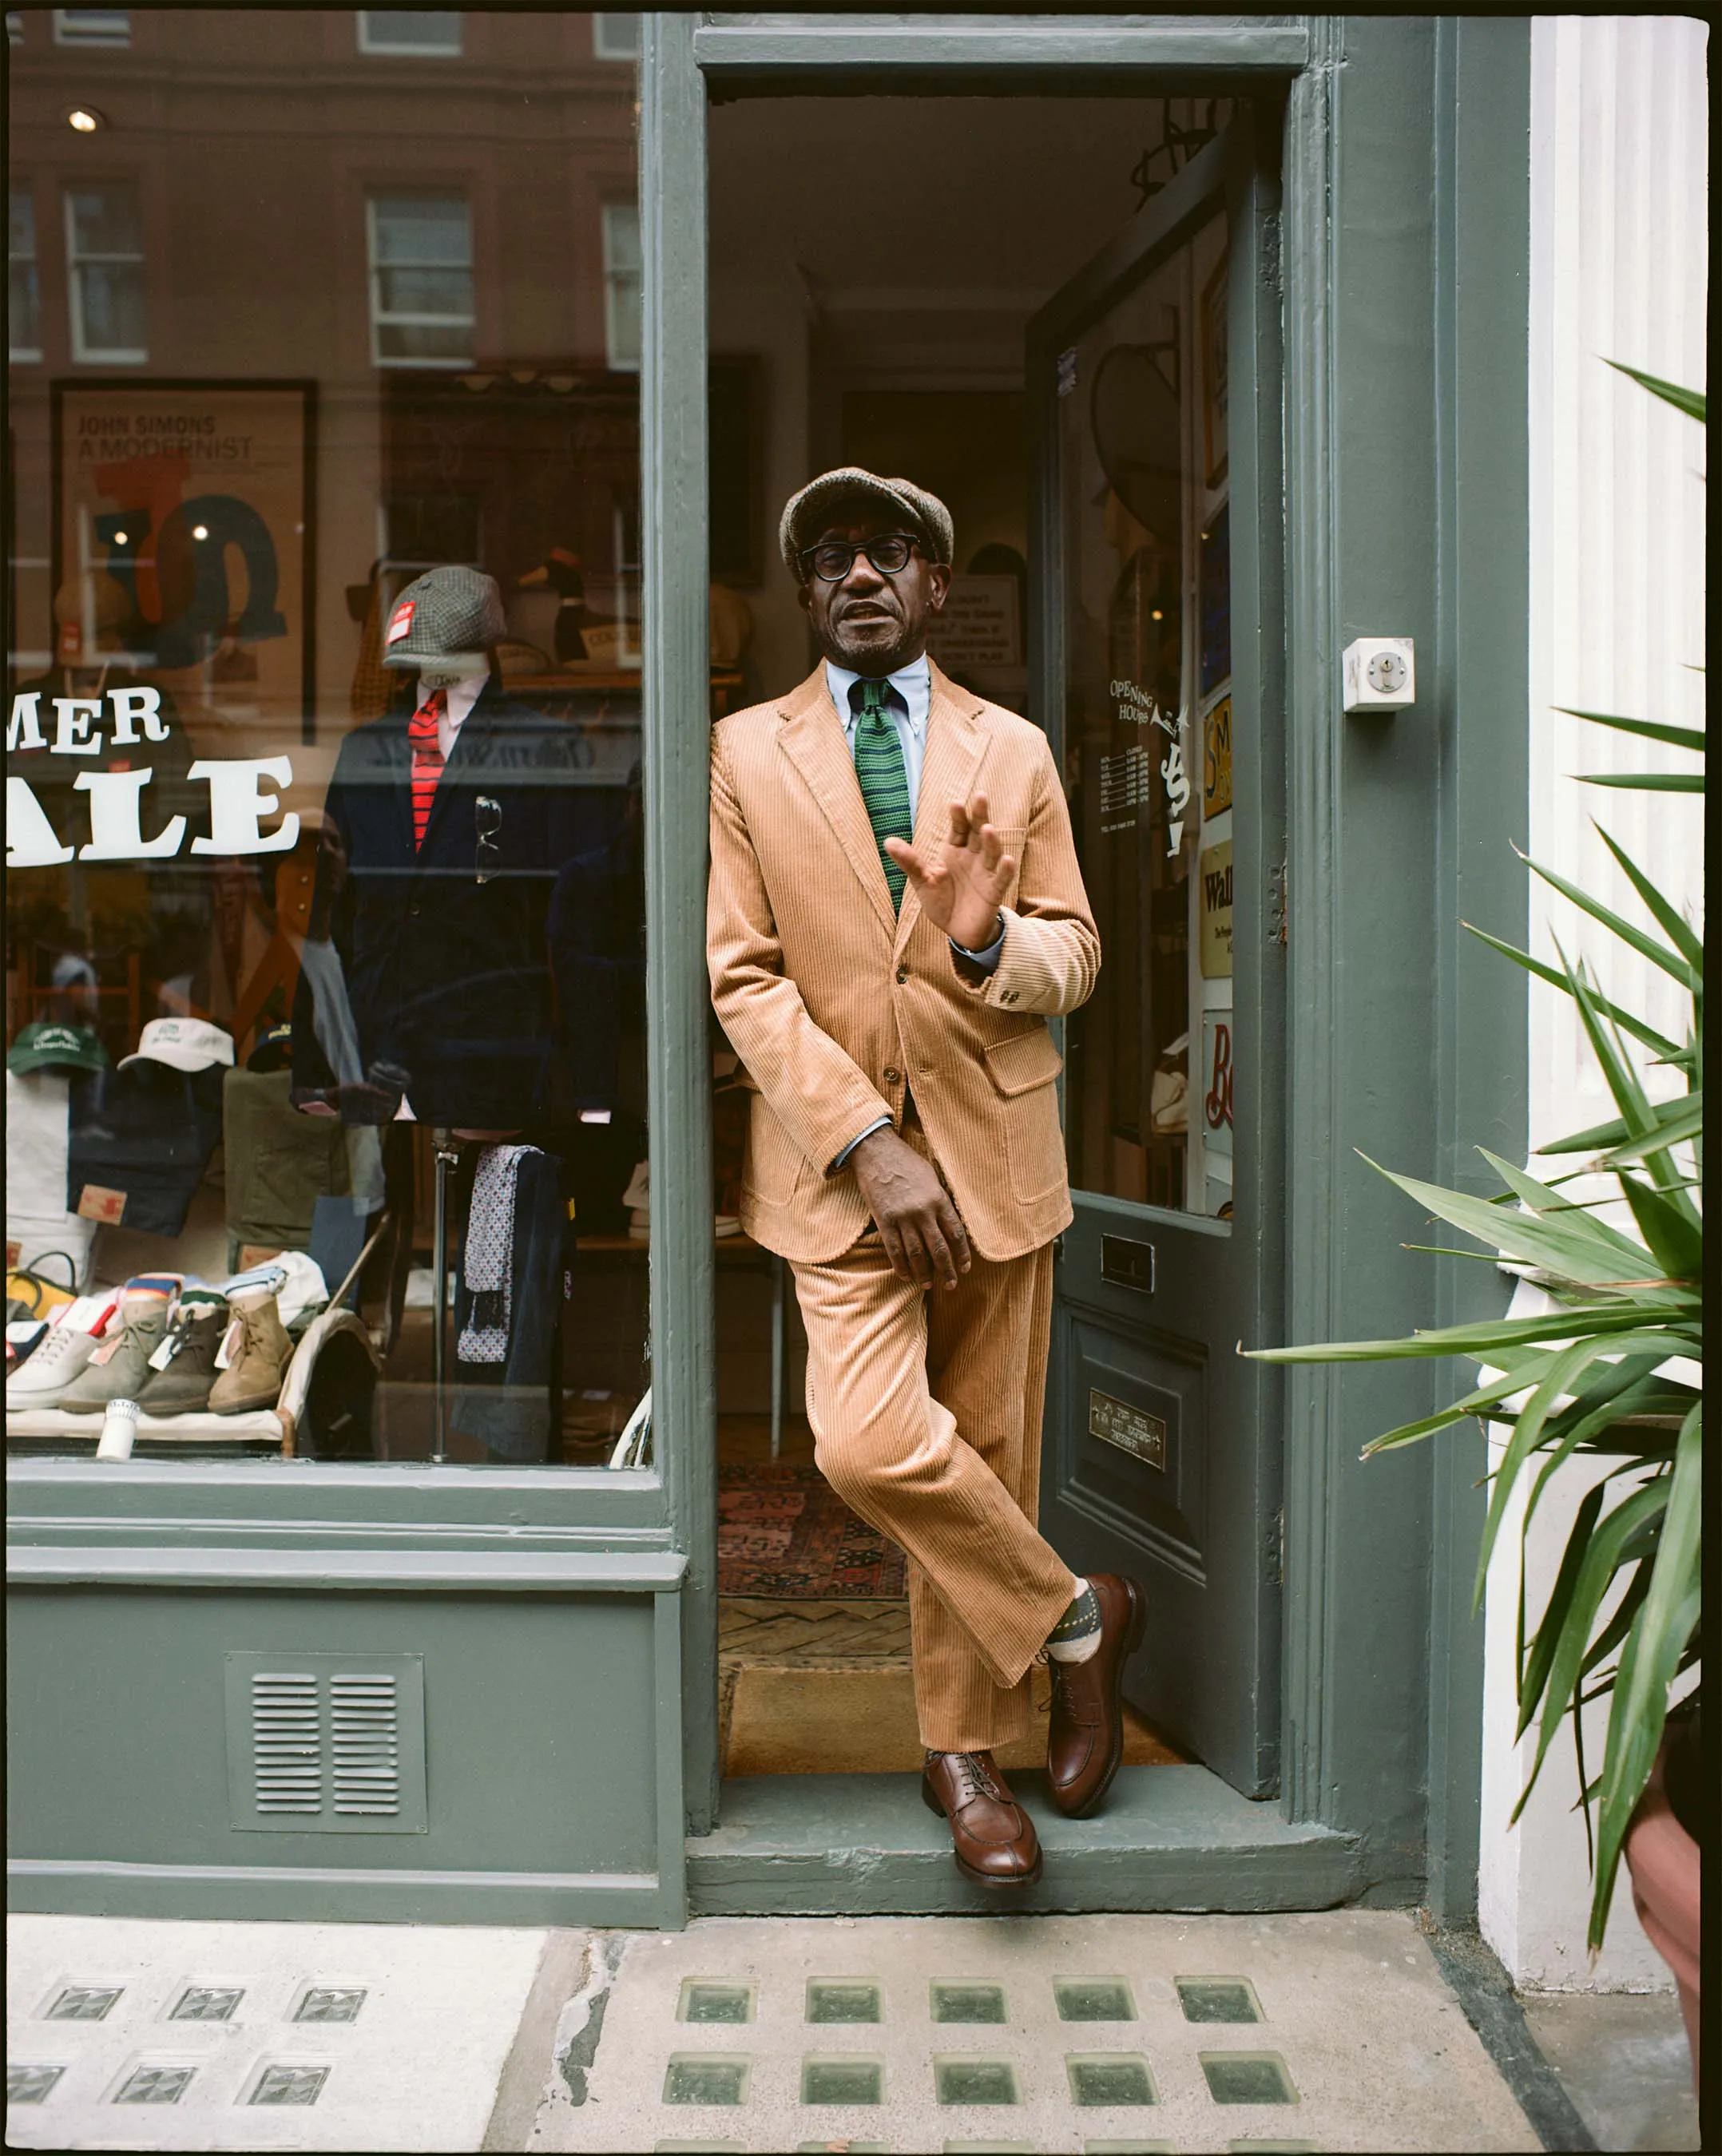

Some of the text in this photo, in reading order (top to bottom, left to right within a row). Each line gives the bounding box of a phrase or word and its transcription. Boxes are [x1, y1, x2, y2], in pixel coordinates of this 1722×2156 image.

[77, 414, 216, 436] JOHN SIMONS
[78, 435, 253, 461] A MODERNIST
[1109, 680, 1153, 708] OPENING
[1118, 703, 1149, 726] HOURS
[6, 755, 300, 868] ALE
